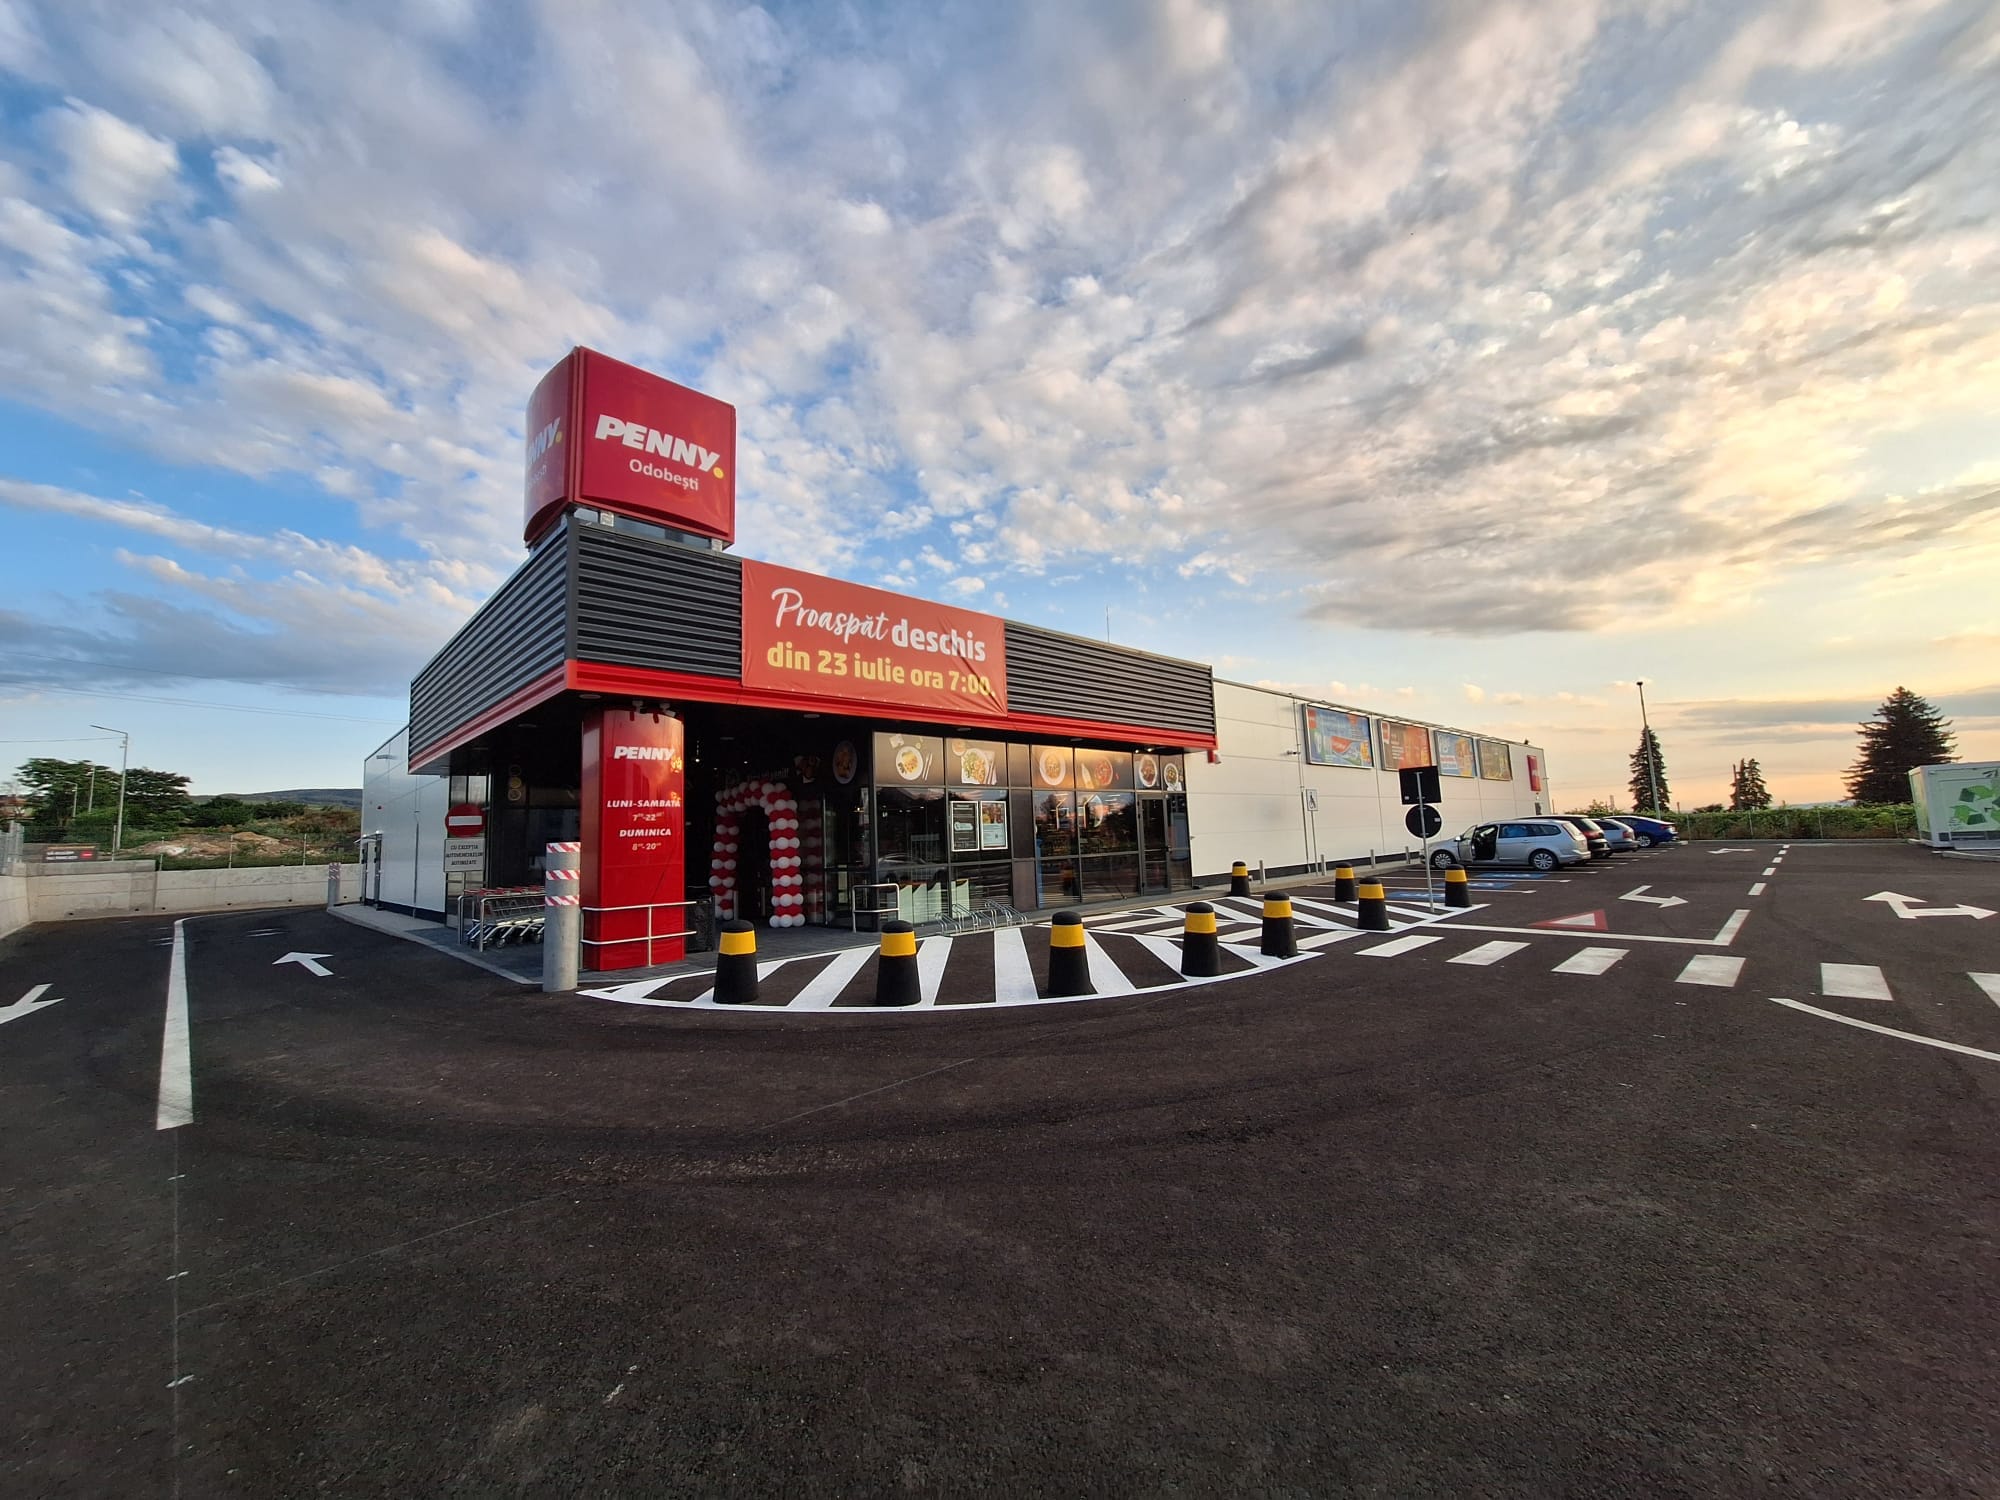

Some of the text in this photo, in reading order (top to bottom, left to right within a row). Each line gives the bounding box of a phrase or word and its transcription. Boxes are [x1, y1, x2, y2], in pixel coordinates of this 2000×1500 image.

[629, 459, 699, 491] Odobești
[771, 587, 986, 662] Proaspăt deschis
[767, 641, 811, 671] din
[817, 650, 848, 676] 23
[854, 653, 905, 684] iulie
[911, 668, 944, 690] ora
[619, 828, 672, 837] DUMINICA
